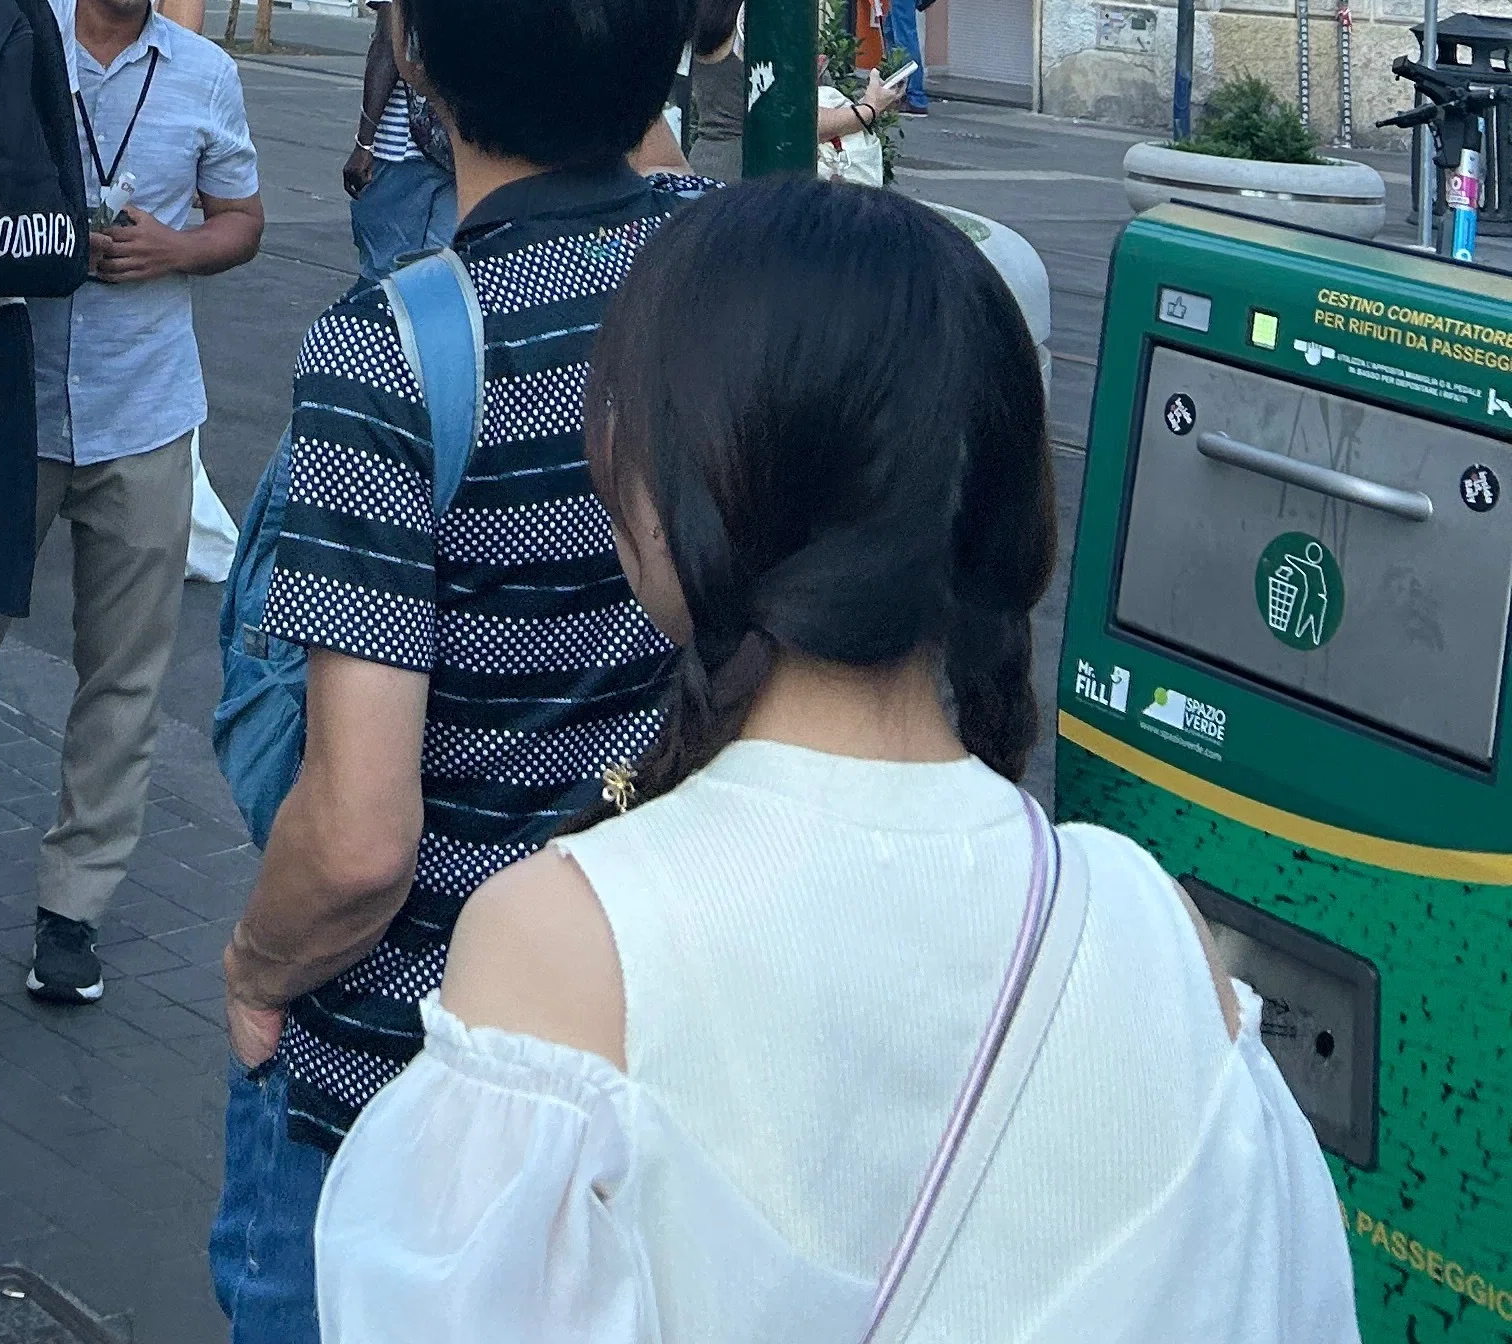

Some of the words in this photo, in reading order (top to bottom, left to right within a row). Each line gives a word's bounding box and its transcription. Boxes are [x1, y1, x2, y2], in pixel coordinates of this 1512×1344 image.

[1314, 308, 1346, 331] PER
[1348, 317, 1403, 345] RIFIUTI
[1405, 330, 1429, 352] DA
[1317, 287, 1385, 317] CESTINO
[1387, 304, 1512, 348] COMPATTATORE
[1077, 658, 1096, 679] Mr.
[1075, 673, 1110, 706] FILL
[1186, 697, 1227, 726] SPAZIO
[1184, 713, 1226, 742] VERDE
